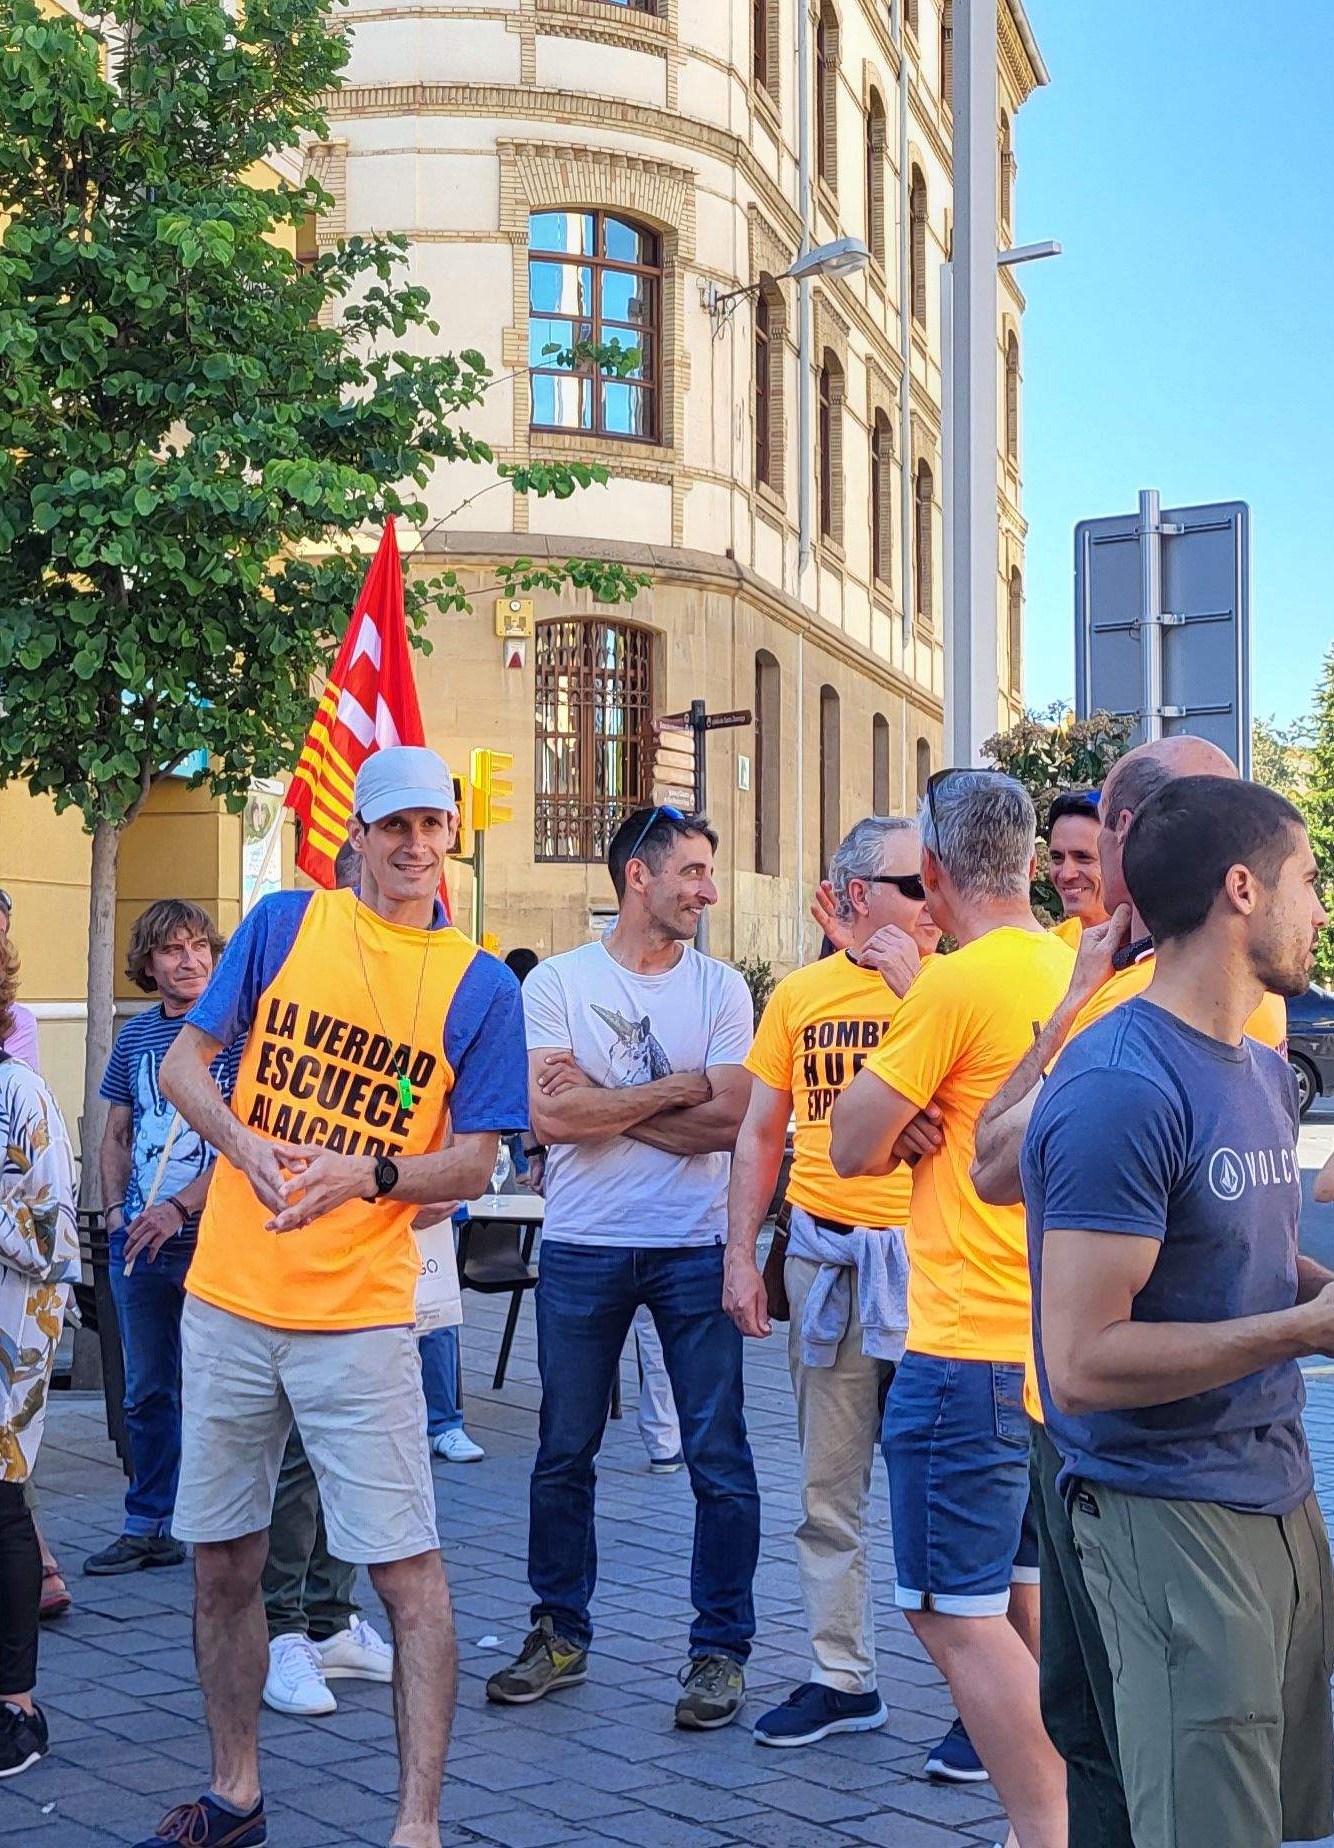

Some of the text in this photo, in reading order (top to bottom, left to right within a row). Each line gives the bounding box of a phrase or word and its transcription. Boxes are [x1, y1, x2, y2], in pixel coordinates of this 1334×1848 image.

[256, 1041, 422, 1138] ESCUECE
[265, 997, 437, 1090] LA VERDAD
